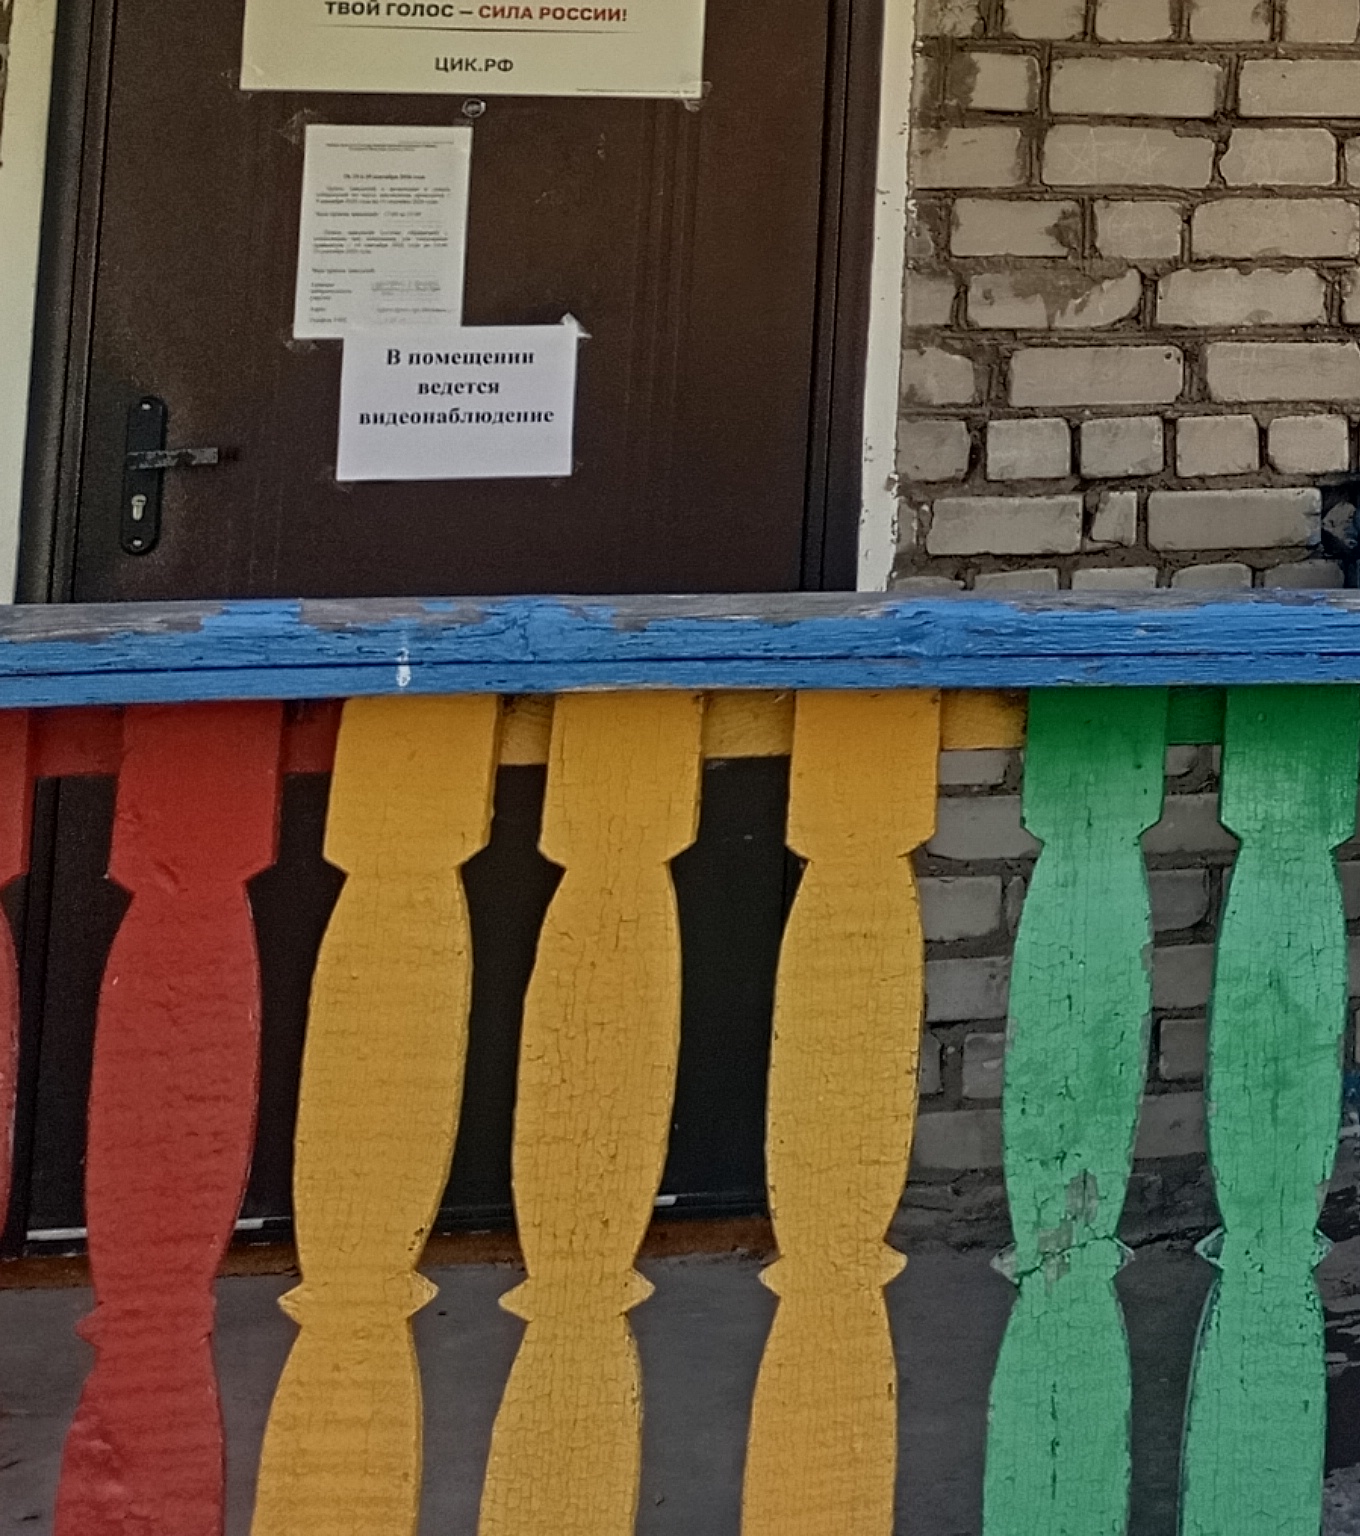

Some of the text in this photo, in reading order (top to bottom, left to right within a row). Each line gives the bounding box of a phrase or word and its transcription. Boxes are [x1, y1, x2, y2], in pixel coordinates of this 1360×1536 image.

[324, 0, 380, 17] ТВОЙ
[386, 3, 454, 19] ГОЛОС
[478, 5, 534, 21] СИЛА
[539, 7, 628, 23] РОССИИ!
[434, 56, 515, 73] ЦИК.РФ
[386, 348, 535, 367] В помещении
[417, 381, 501, 397] ведется
[359, 406, 556, 427] видеонаблюдение
